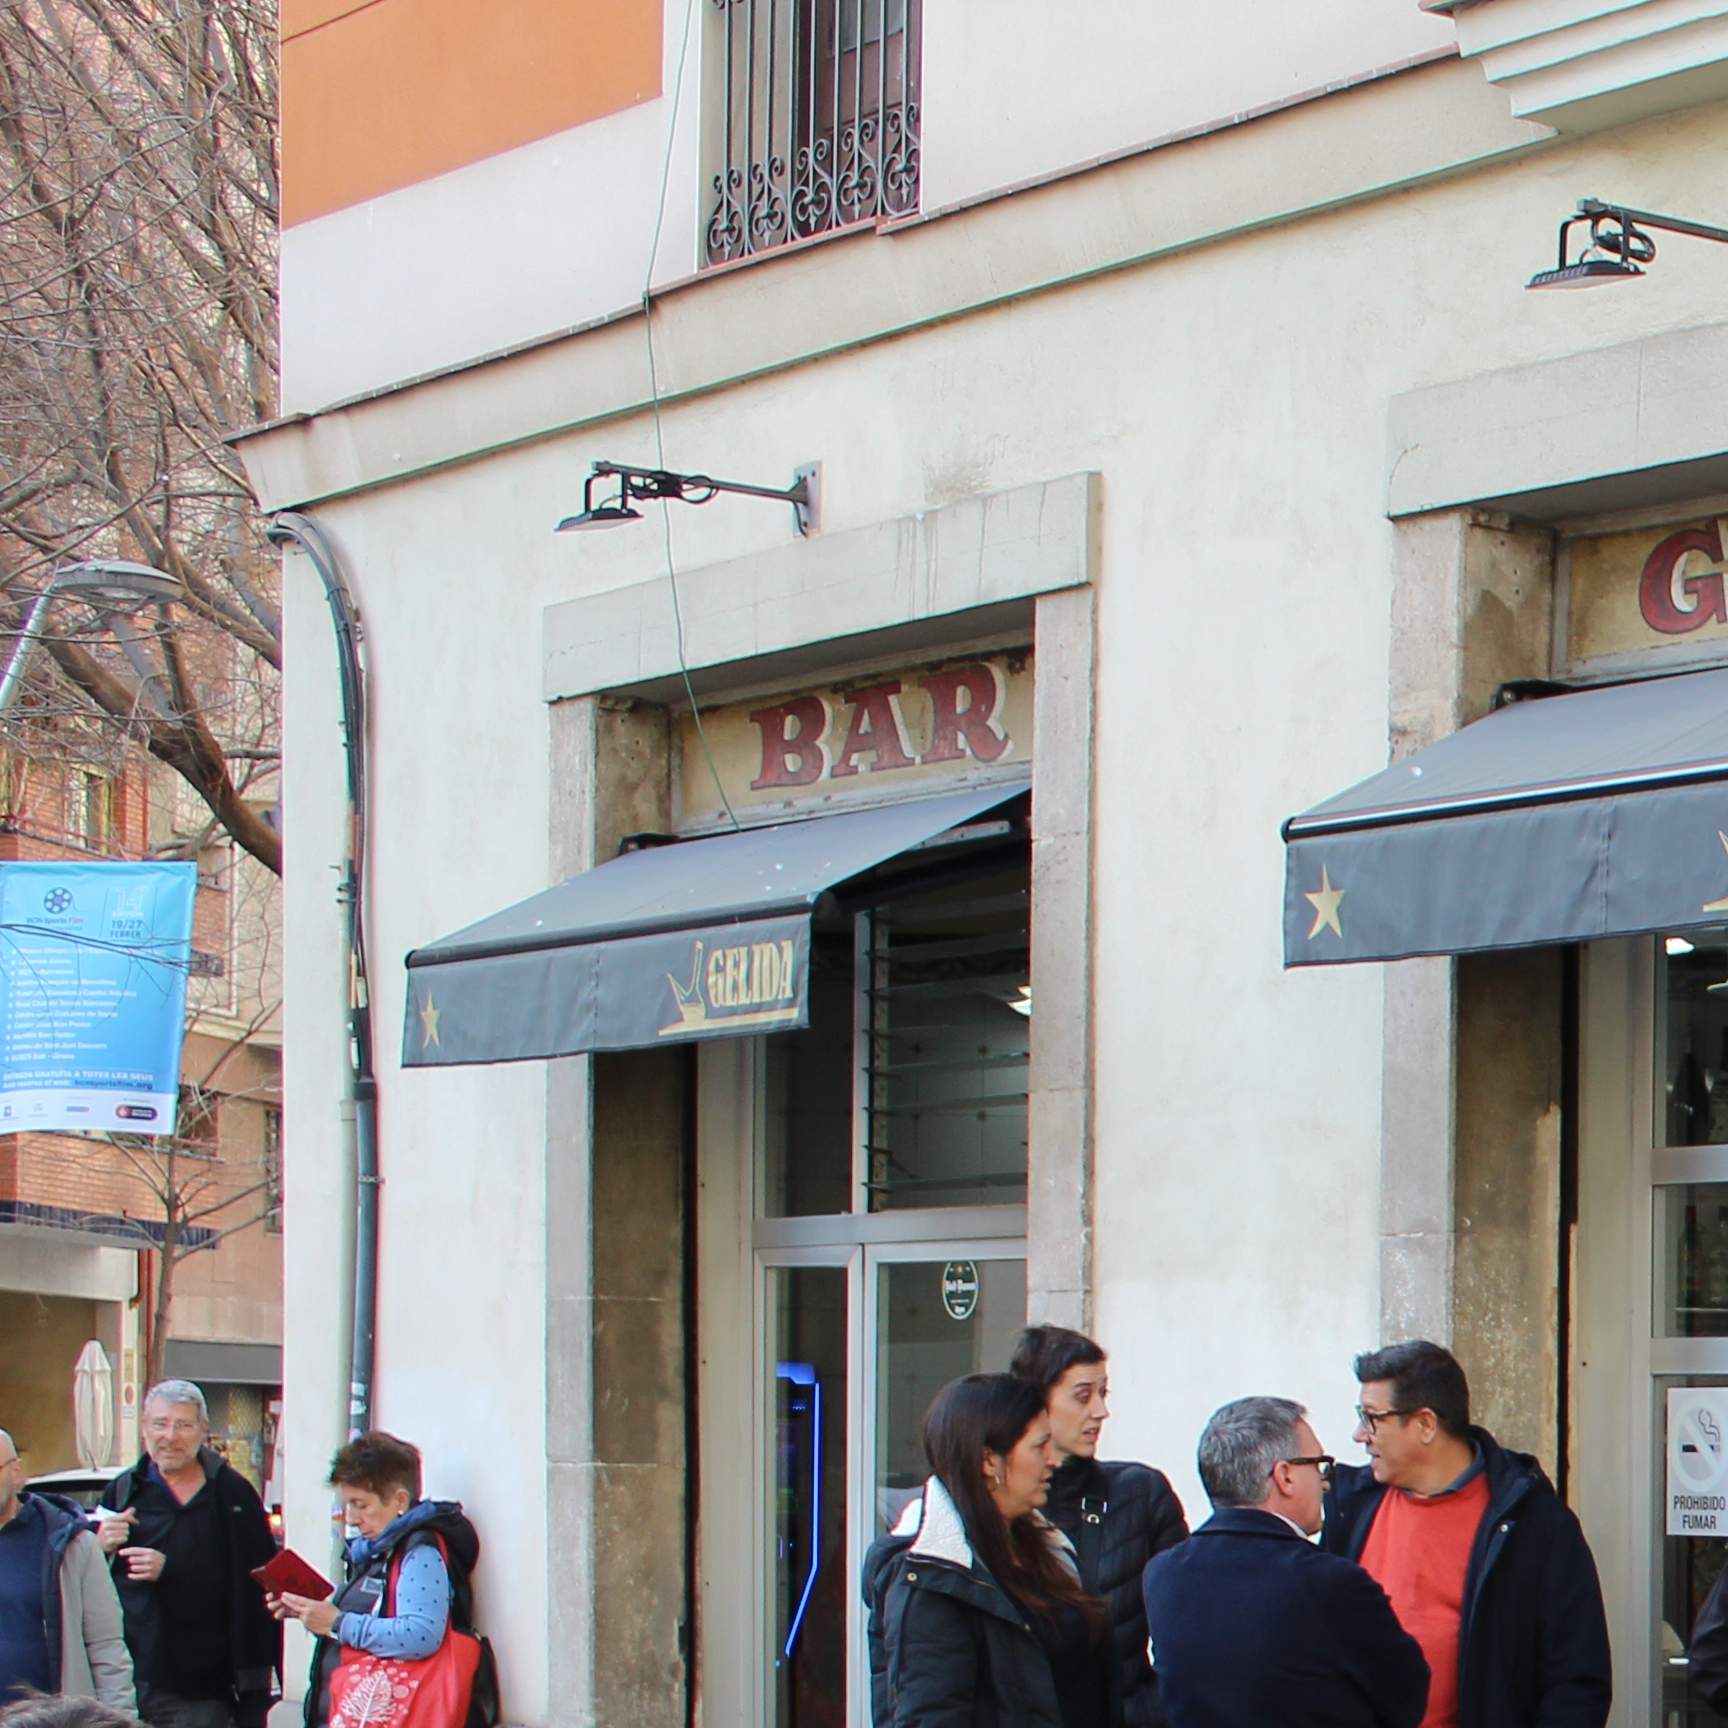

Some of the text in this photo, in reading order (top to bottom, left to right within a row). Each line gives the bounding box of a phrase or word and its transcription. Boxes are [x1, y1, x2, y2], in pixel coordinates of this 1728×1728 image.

[750, 661, 1011, 791] BAR
[706, 938, 795, 1009] GELIDA
[1673, 1495, 1726, 1510] PROHIBIDO
[1682, 1514, 1717, 1530] FUMAR
